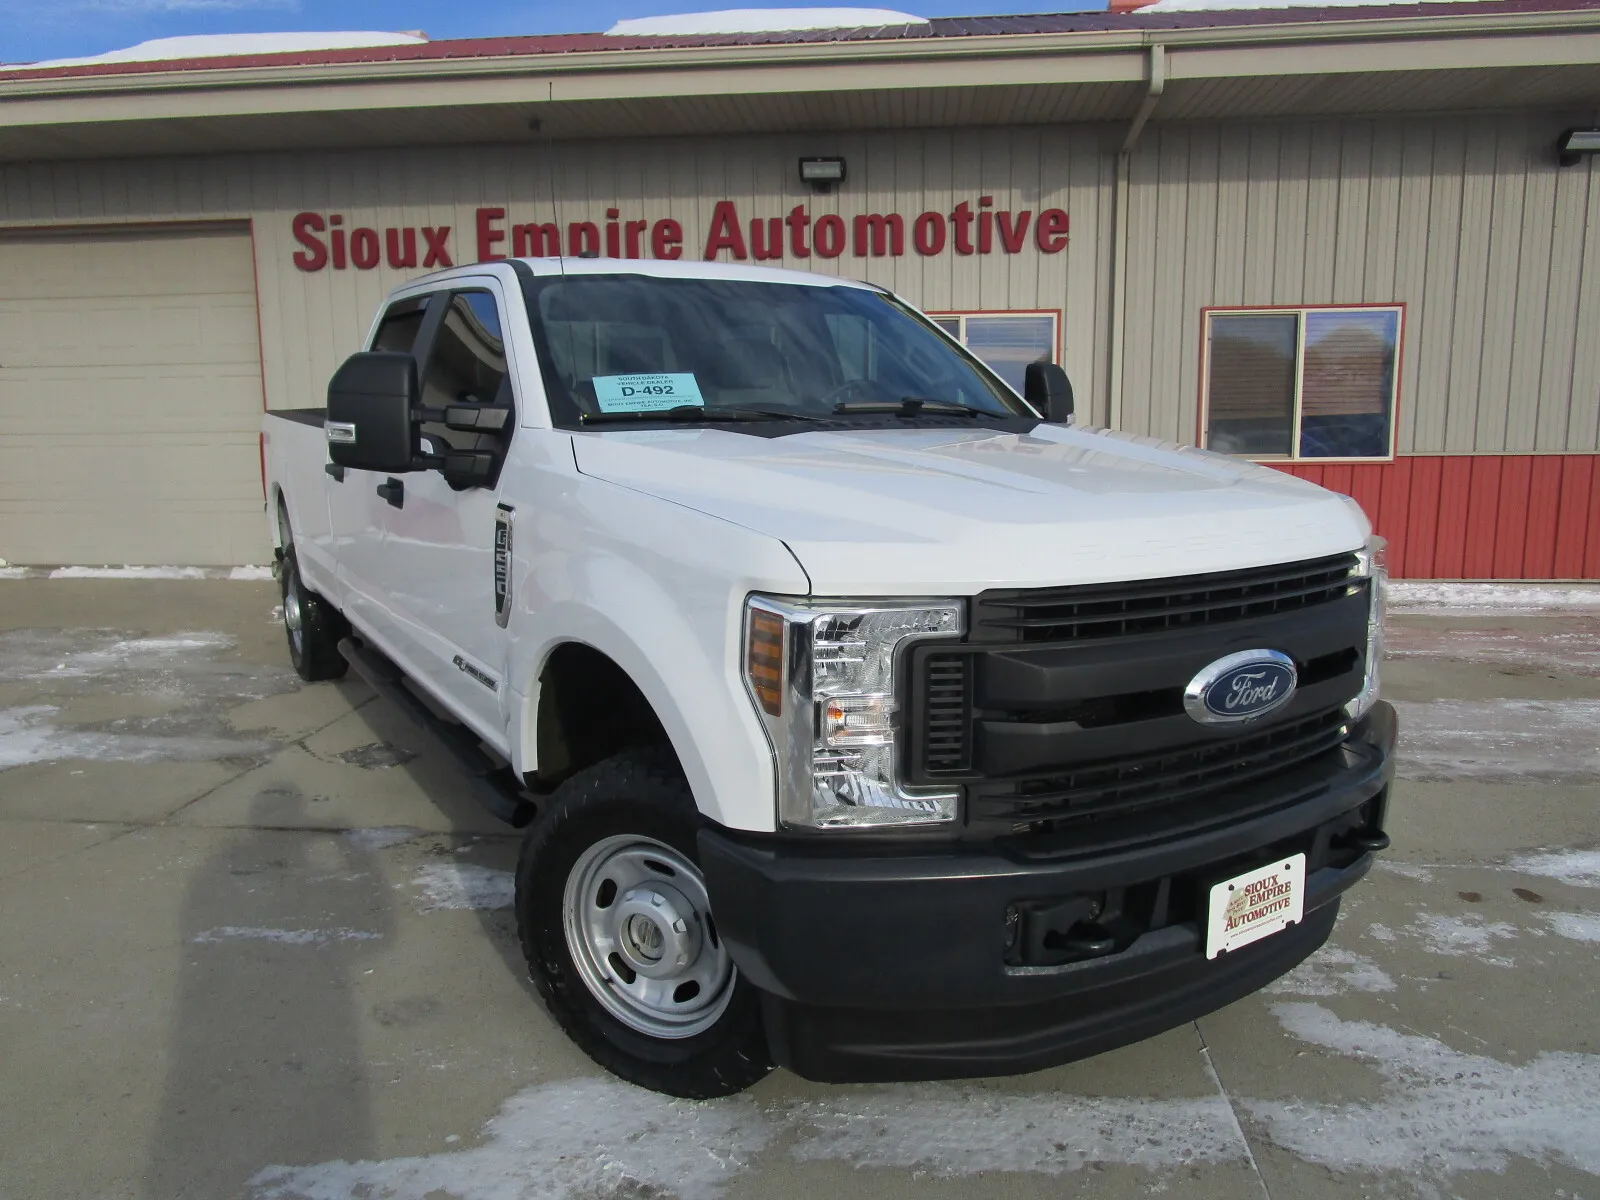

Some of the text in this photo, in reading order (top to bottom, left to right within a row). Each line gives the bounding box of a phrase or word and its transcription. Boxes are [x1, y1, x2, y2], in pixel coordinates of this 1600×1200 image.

[292, 196, 1070, 272] Sioux Empire Automotive
[621, 385, 675, 397] D-492
[1225, 671, 1279, 709] Ford
[1244, 874, 1279, 897] SIOUX
[1248, 881, 1291, 907] EMPIRE
[1224, 897, 1291, 932] AUTOMOTIVE
